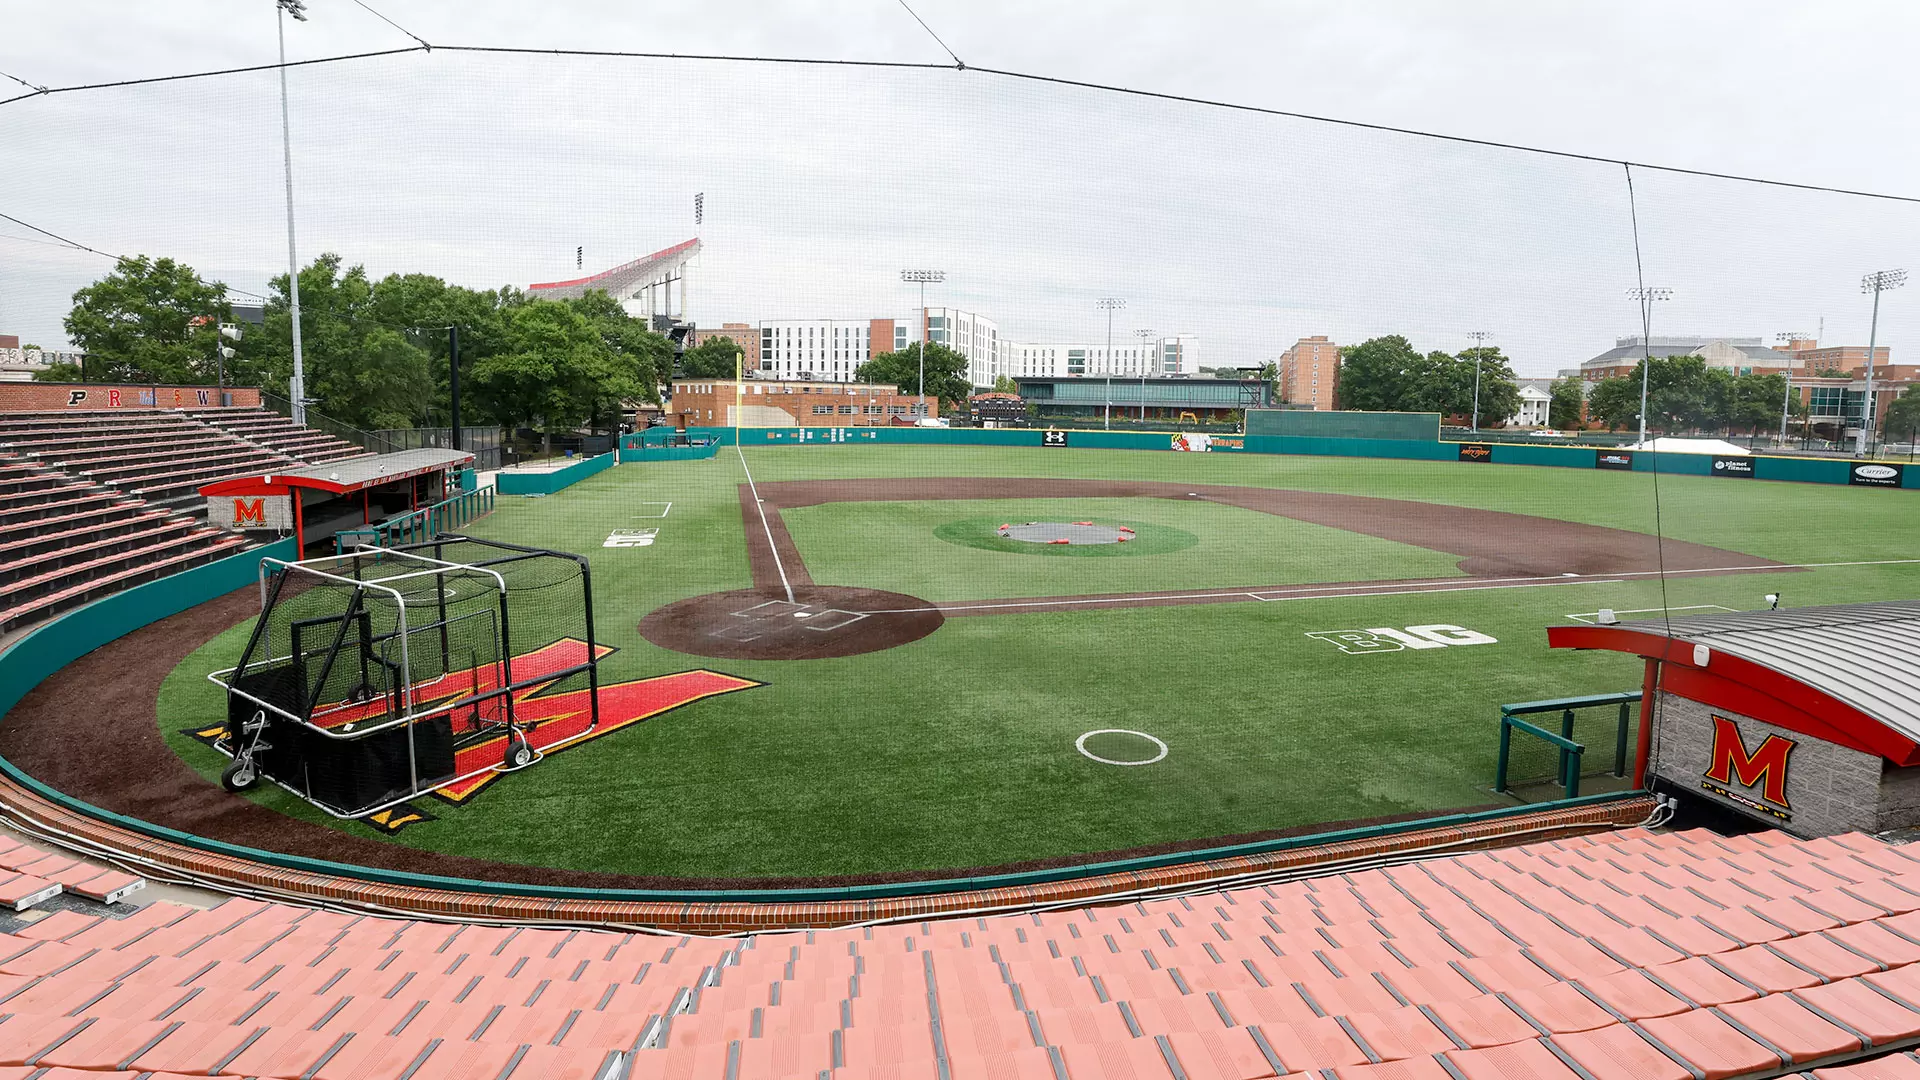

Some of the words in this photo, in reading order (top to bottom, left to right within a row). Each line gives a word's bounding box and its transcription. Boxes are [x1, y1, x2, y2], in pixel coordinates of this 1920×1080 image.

[68, 390, 87, 406] P
[108, 389, 121, 407] R
[197, 390, 209, 406] W
[232, 498, 266, 523] M
[1704, 714, 1798, 810] M
